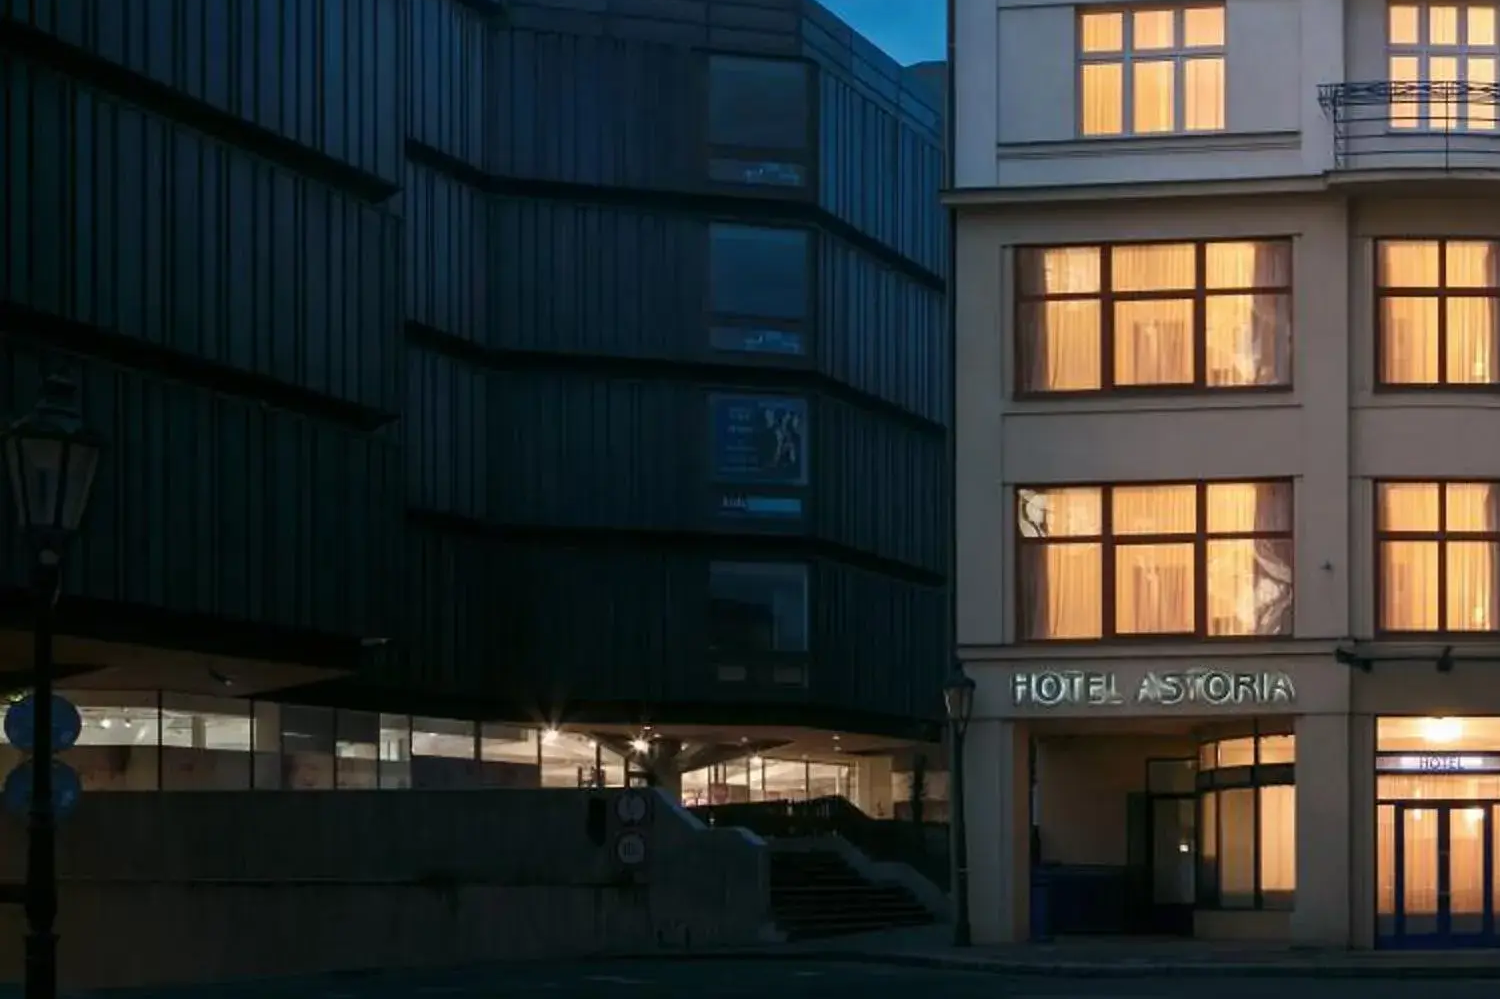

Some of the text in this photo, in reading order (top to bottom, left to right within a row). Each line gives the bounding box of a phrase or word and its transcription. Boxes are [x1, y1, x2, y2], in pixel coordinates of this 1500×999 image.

[1011, 670, 1296, 705] HOTEL ASTORIA
[1419, 755, 1465, 770] HOTEL
